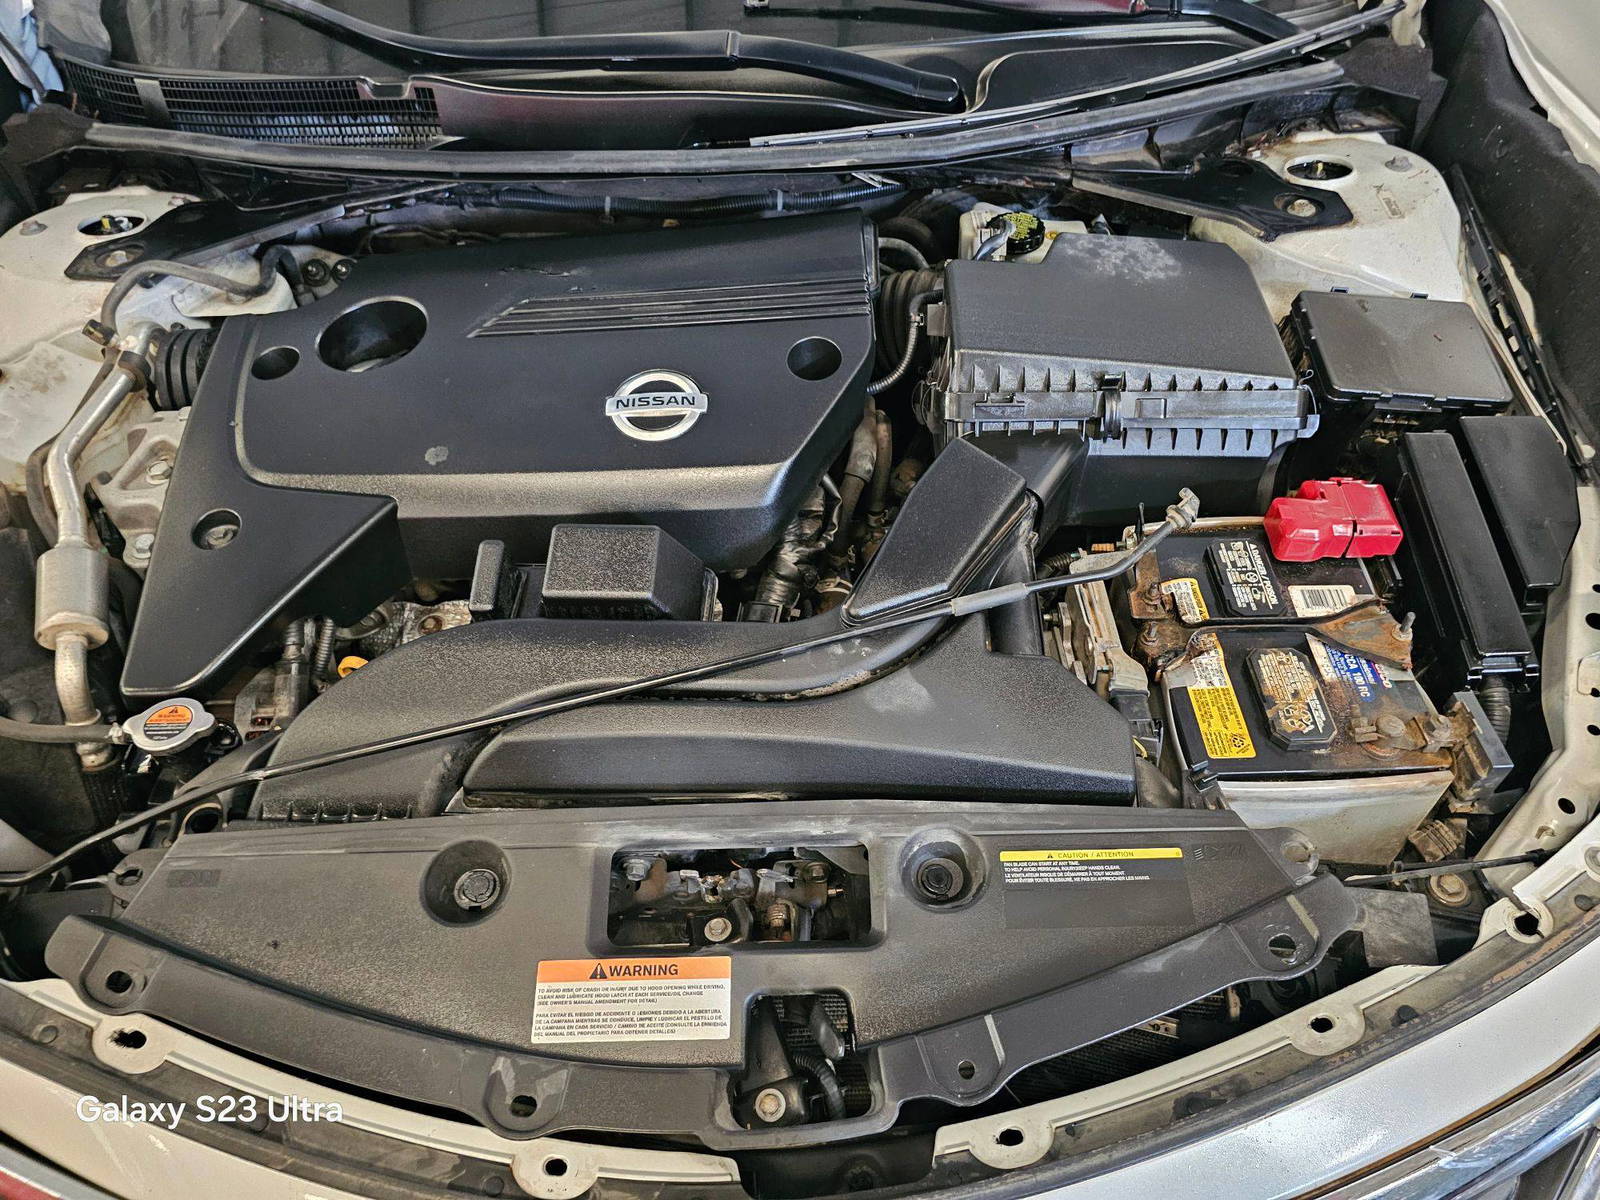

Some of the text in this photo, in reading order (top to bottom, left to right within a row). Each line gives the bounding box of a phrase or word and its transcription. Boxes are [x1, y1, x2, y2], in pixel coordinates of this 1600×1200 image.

[616, 396, 696, 409] NISSAN
[1252, 549, 1268, 576] DANGER
[1262, 580, 1279, 605] POISON
[1344, 654, 1370, 697] CCA 100 RC
[609, 964, 679, 977] WARNING
